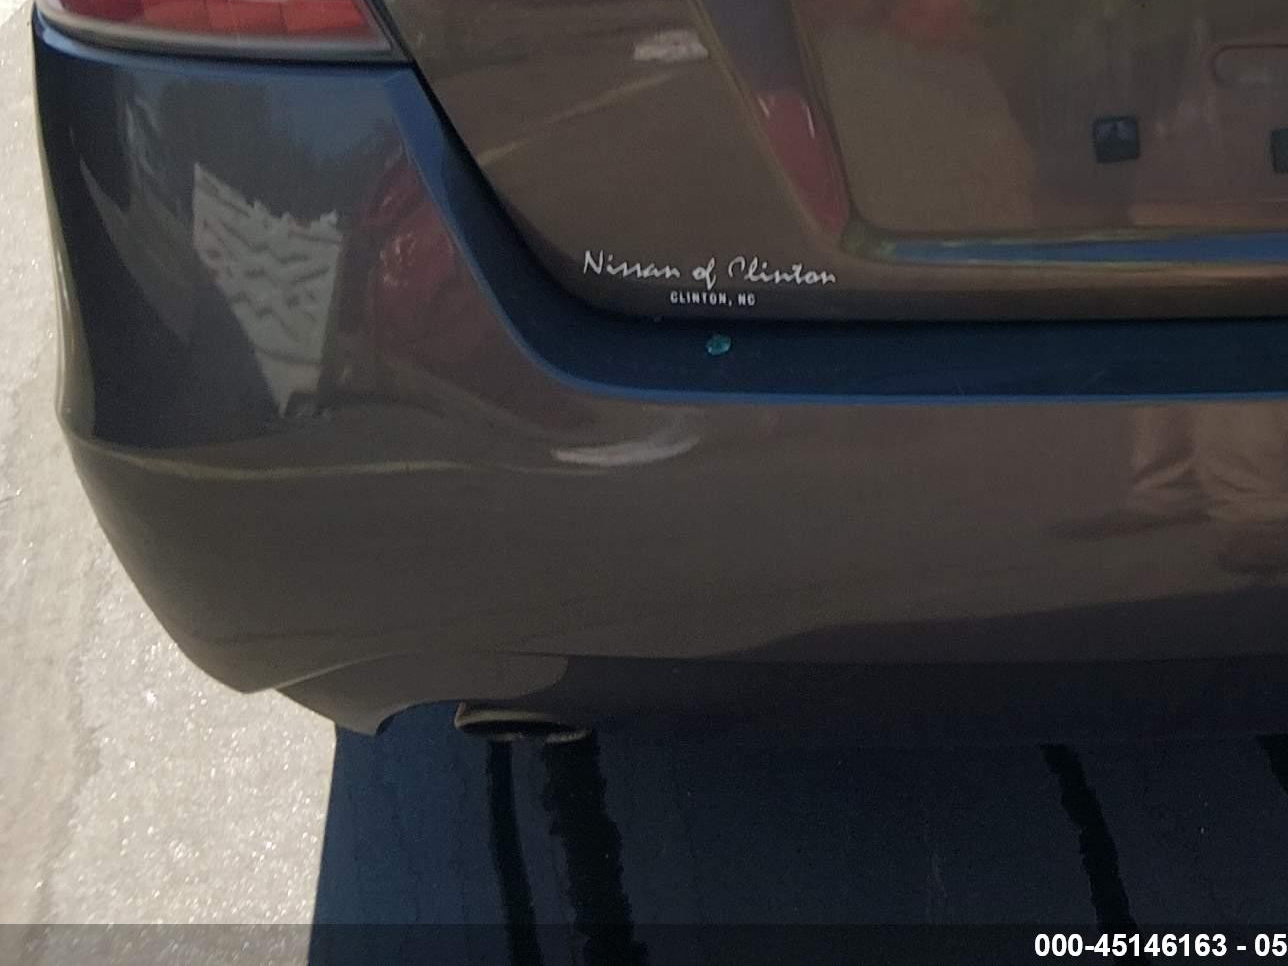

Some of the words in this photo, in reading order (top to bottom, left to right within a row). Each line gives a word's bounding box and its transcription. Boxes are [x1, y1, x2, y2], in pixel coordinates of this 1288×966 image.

[583, 250, 681, 279] Nissan
[692, 257, 717, 290] of
[728, 256, 836, 285] Clinton
[669, 291, 733, 307] CLINTON,
[738, 293, 756, 307] NC
